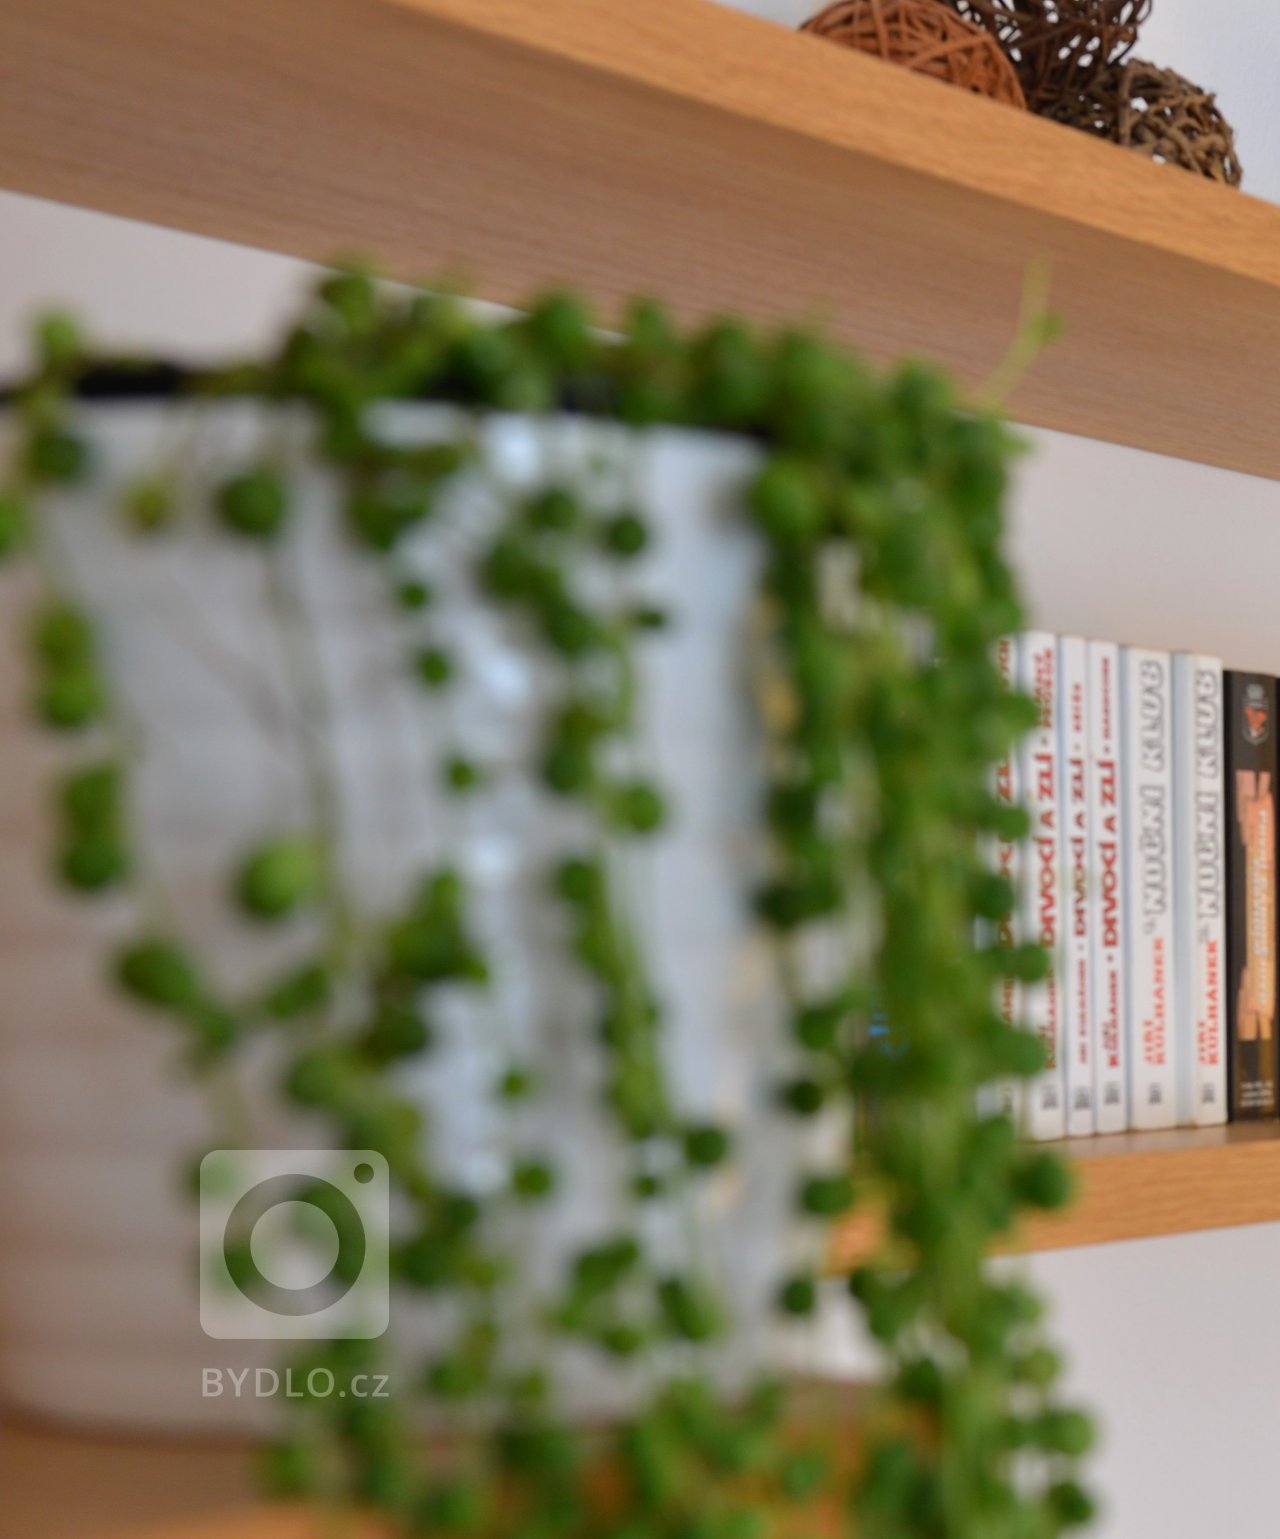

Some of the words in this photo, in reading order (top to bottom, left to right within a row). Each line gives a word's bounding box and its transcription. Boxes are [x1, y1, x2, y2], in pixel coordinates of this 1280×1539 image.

[1140, 658, 1166, 774] KLUB
[1034, 752, 1056, 802] ZLÍ
[1069, 755, 1086, 803] ZLÍ
[1097, 758, 1118, 806] ZLÍ
[1041, 810, 1057, 829] A
[1076, 810, 1087, 829] A
[1107, 814, 1118, 834] A
[1033, 836, 1057, 949] DIVOCÍ
[1071, 836, 1088, 940] DIVOCÍ
[1098, 840, 1119, 949] DIVOCÍ
